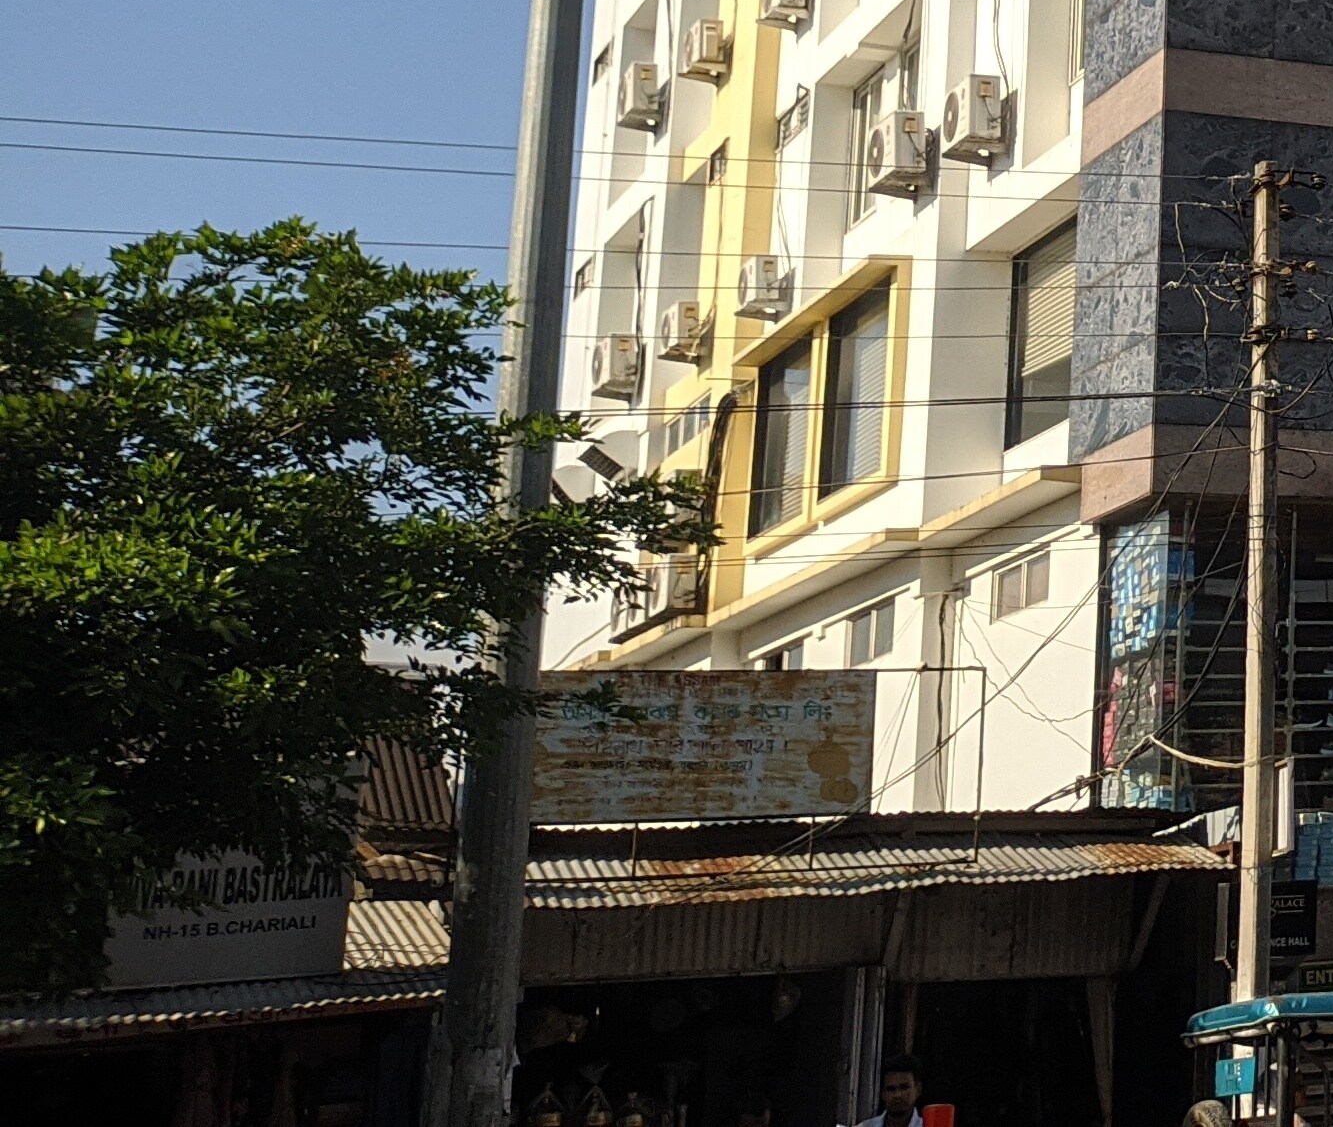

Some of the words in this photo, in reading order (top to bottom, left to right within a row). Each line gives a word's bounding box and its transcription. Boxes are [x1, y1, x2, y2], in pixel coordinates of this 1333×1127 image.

[144, 924, 201, 940] NH-15
[206, 915, 317, 937] B.CHARIALI
[1288, 936, 1311, 947] HALL
